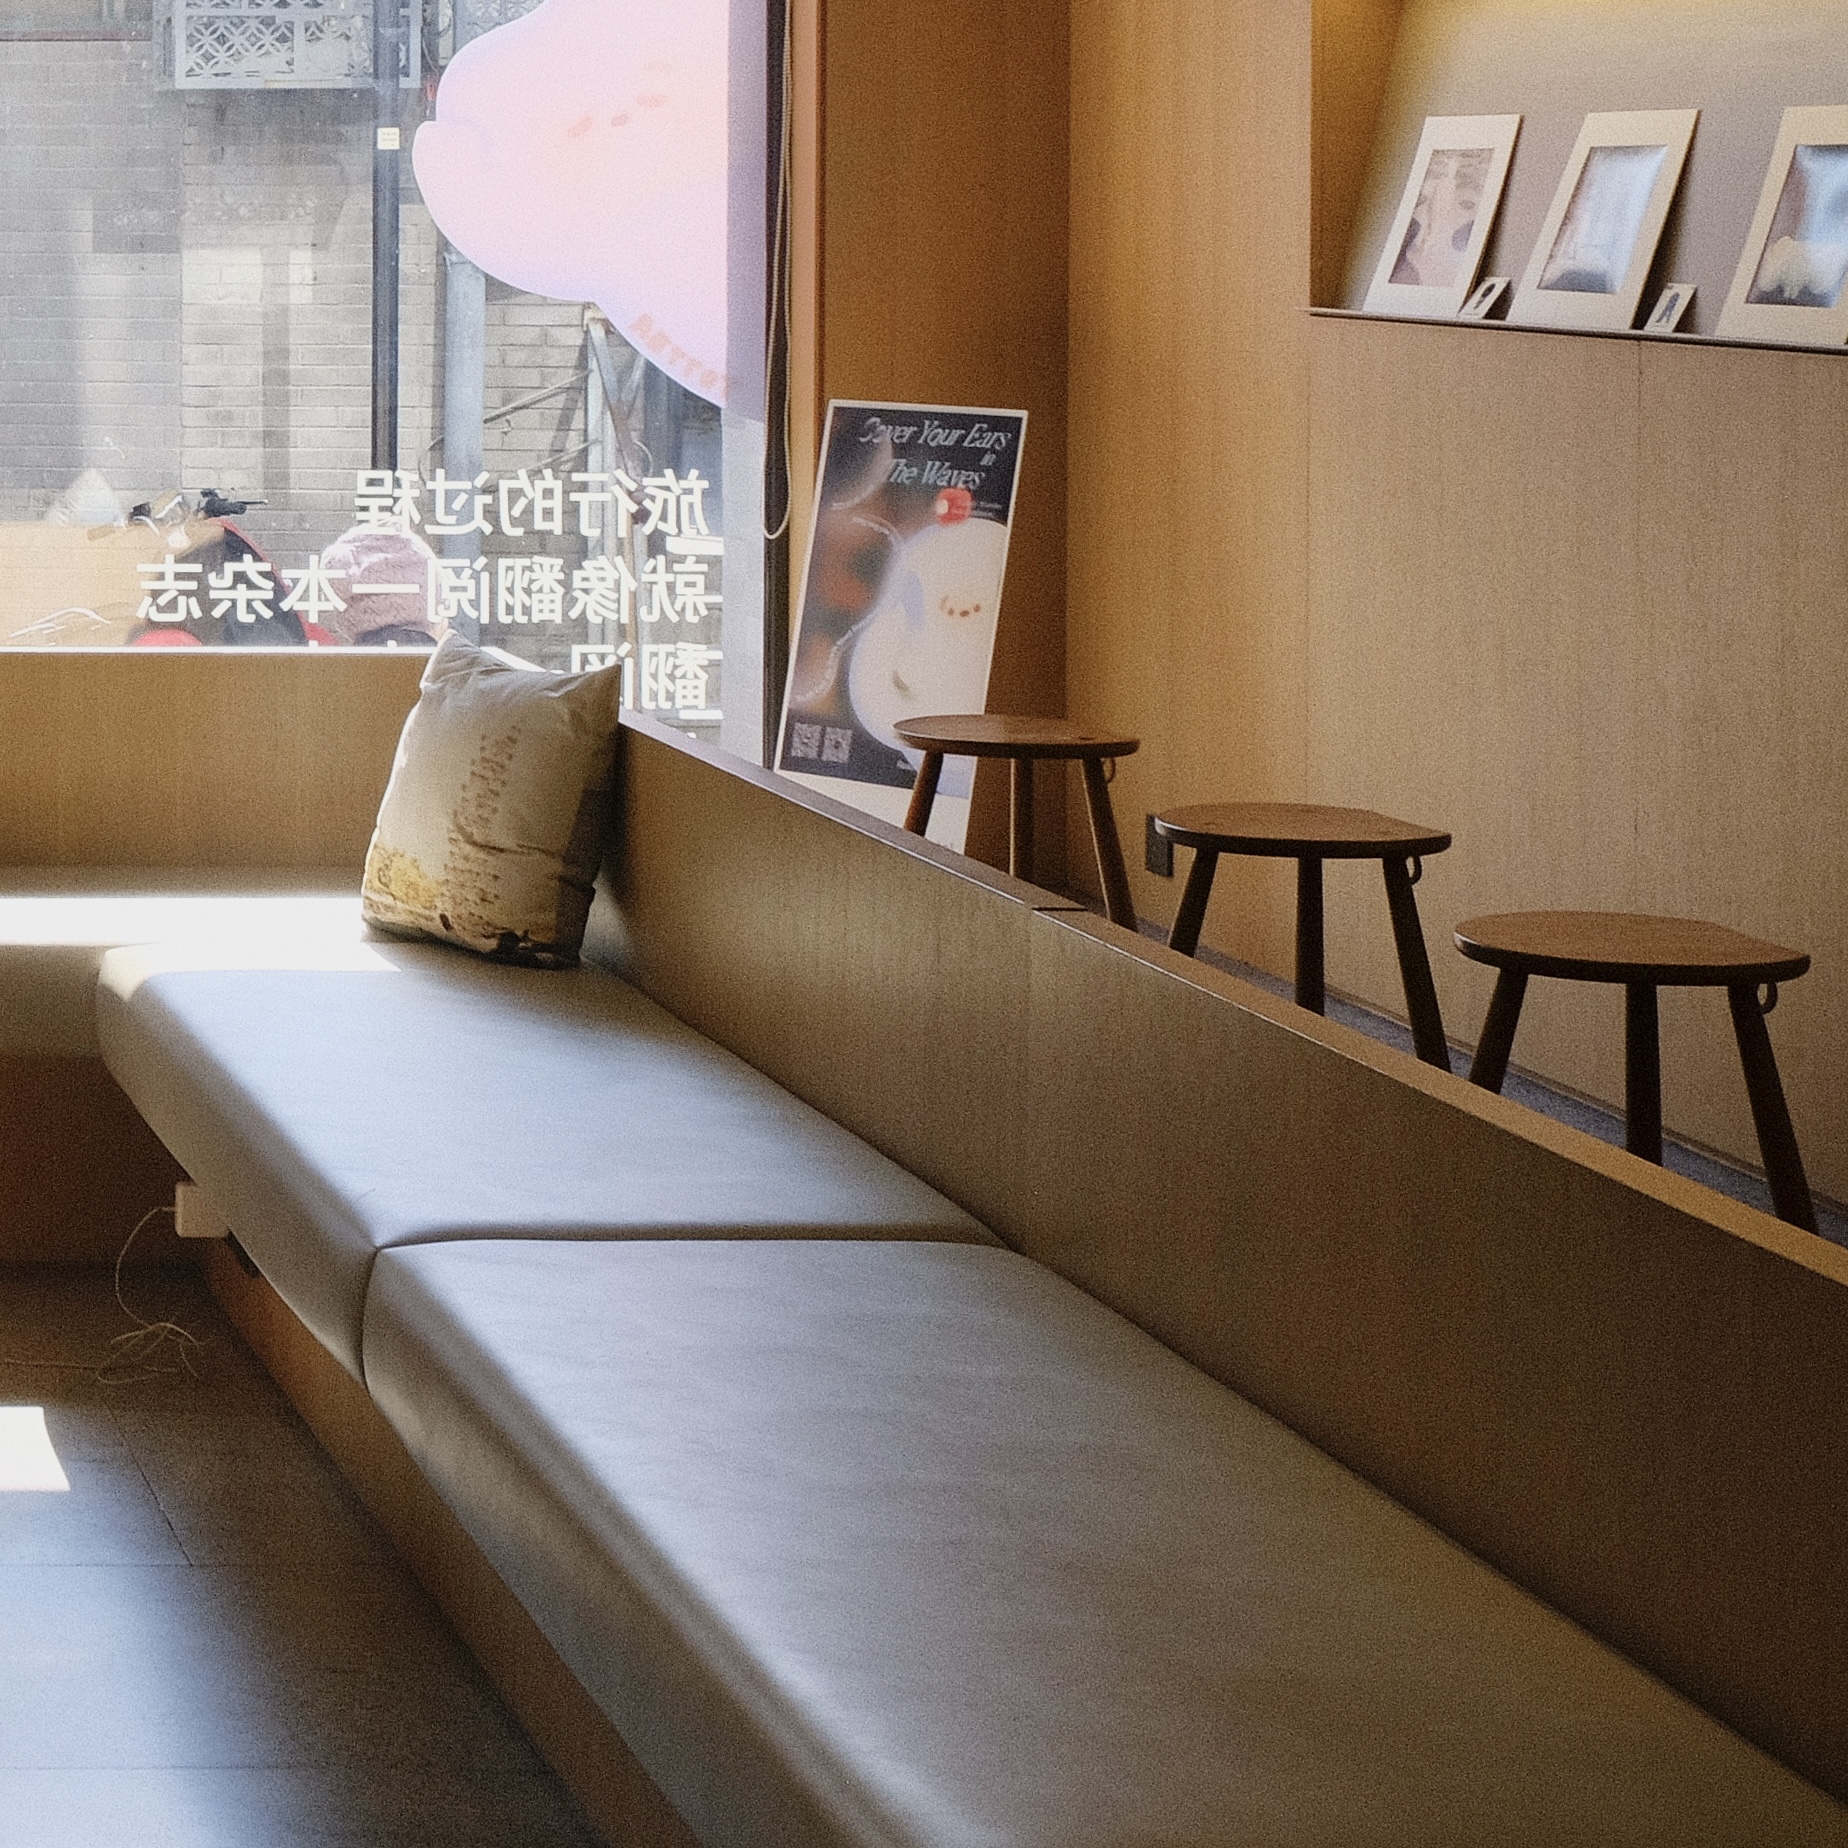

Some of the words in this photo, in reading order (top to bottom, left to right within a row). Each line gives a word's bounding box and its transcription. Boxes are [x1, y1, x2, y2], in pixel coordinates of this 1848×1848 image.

[917, 420, 964, 447] Your
[963, 423, 1011, 450] Ears
[889, 458, 917, 485] The
[922, 460, 986, 489] Waves
